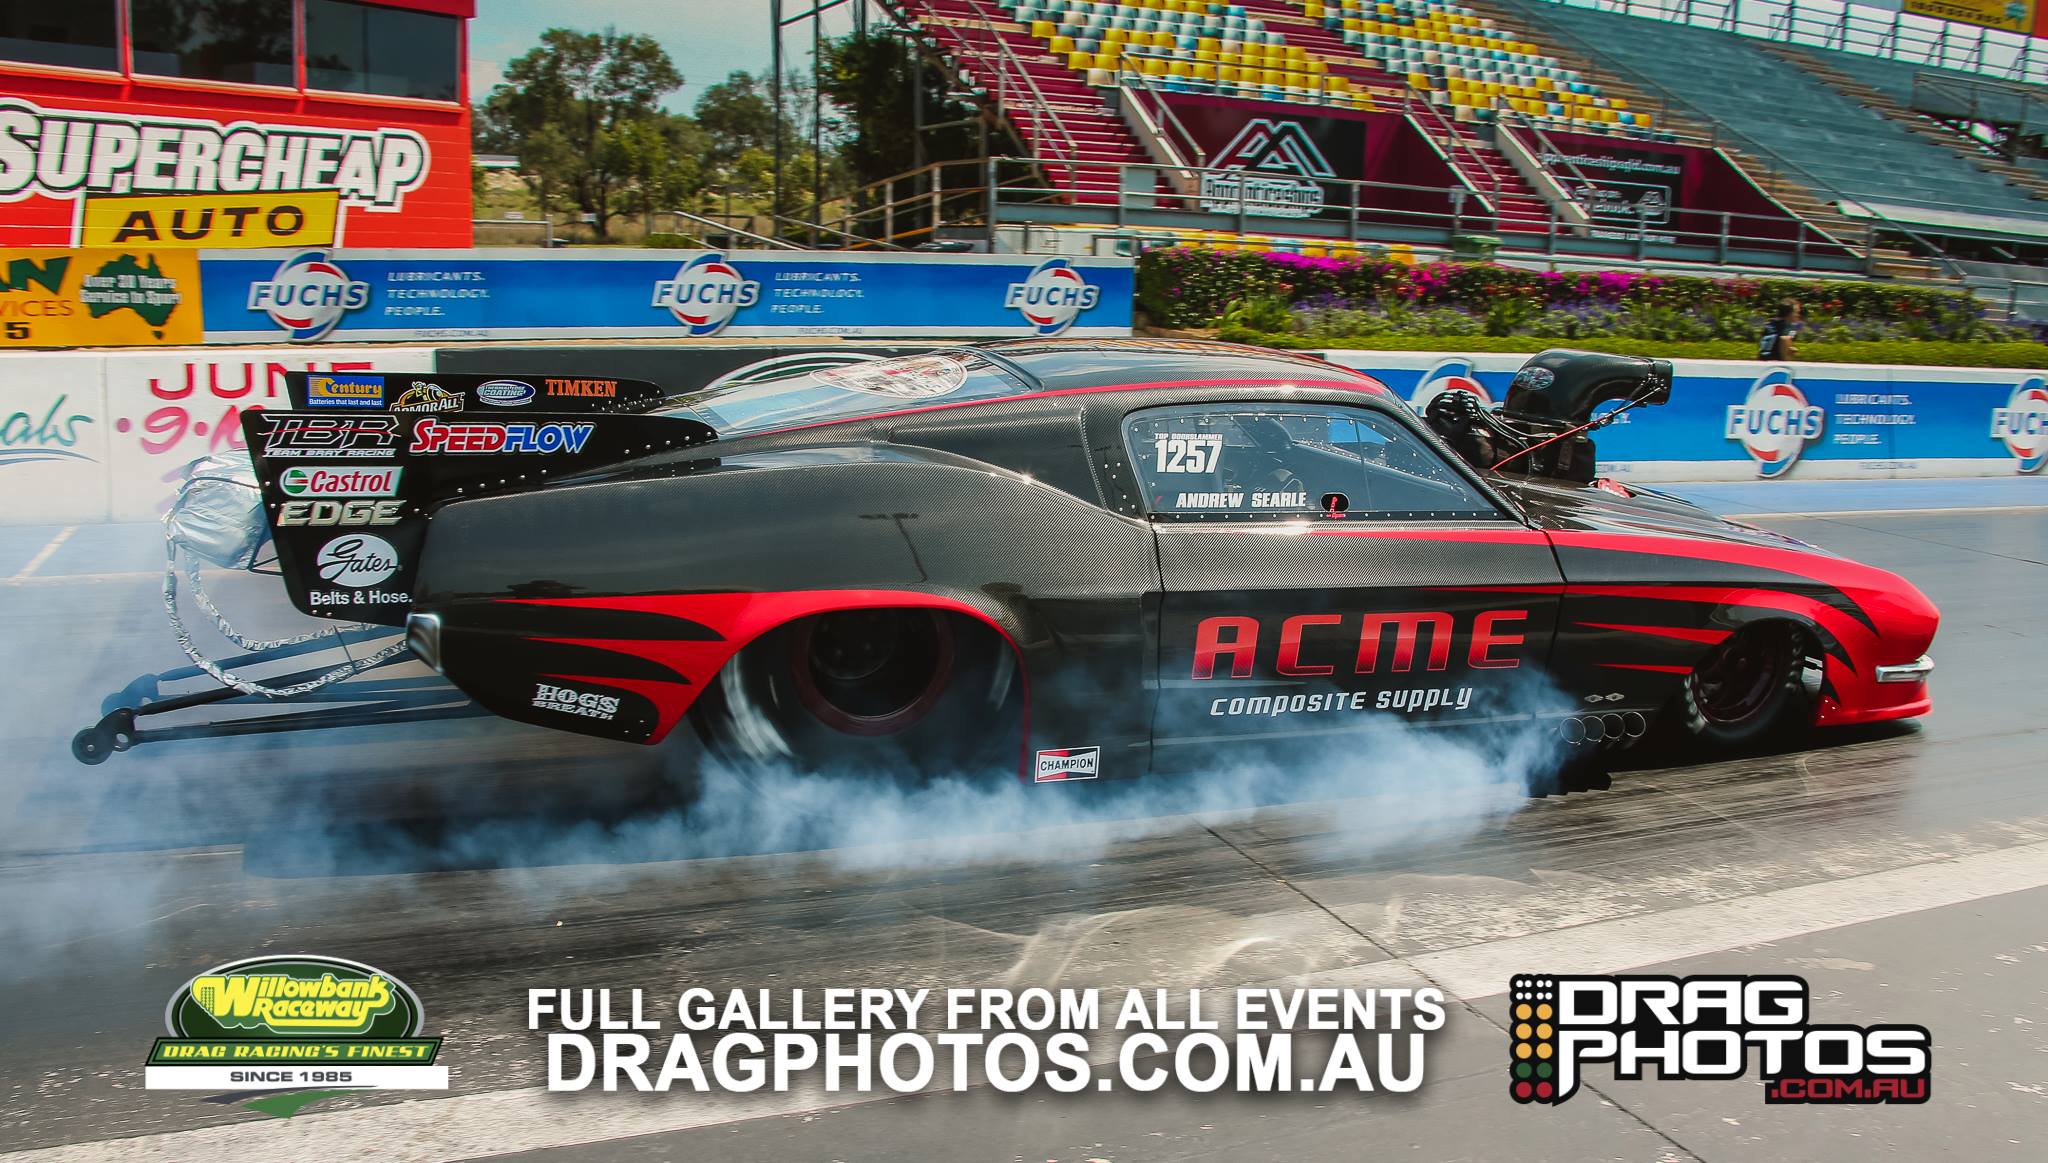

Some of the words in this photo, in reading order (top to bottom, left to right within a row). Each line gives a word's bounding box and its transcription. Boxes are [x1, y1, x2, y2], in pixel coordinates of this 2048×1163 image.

[0, 105, 425, 206] SUPERCHEAP
[112, 206, 305, 243] AUTO
[387, 271, 486, 282] LUBRICANTS.
[774, 272, 862, 282] LUBRICANTS.
[252, 283, 369, 307] FUCHS
[387, 288, 490, 299] TECHNOLOGY.
[656, 282, 756, 305] FUCHS
[773, 288, 865, 298] TECHNOLOGY.
[1009, 286, 1099, 307] FUCHS
[384, 306, 446, 316] PEOPLE.
[770, 304, 825, 314] PEOPLE.
[147, 362, 373, 400] JUN
[310, 377, 383, 398] Century
[545, 378, 618, 398] TIMKEN
[1835, 394, 1913, 405] LUBRICANTS.
[1729, 408, 1822, 435] FUCHS
[1835, 414, 1916, 425] TECHNOLOGY.
[261, 413, 400, 449] TBR
[1833, 434, 1882, 445] PEOPLE.
[264, 449, 301, 458] TEAM
[344, 449, 396, 458] RACING
[1155, 440, 1223, 473] 1257
[310, 470, 393, 493] Castrol
[1176, 492, 1244, 509] ANDREW
[1252, 492, 1307, 508] SEARLE
[277, 500, 407, 527] EDGE
[318, 538, 399, 582] Gates
[310, 591, 350, 606] Belts
[353, 591, 366, 605] &
[369, 590, 413, 605] Hose.
[1191, 609, 1529, 681] ACME
[532, 700, 614, 721] BREATH
[1040, 758, 1094, 771] CHAMPION
